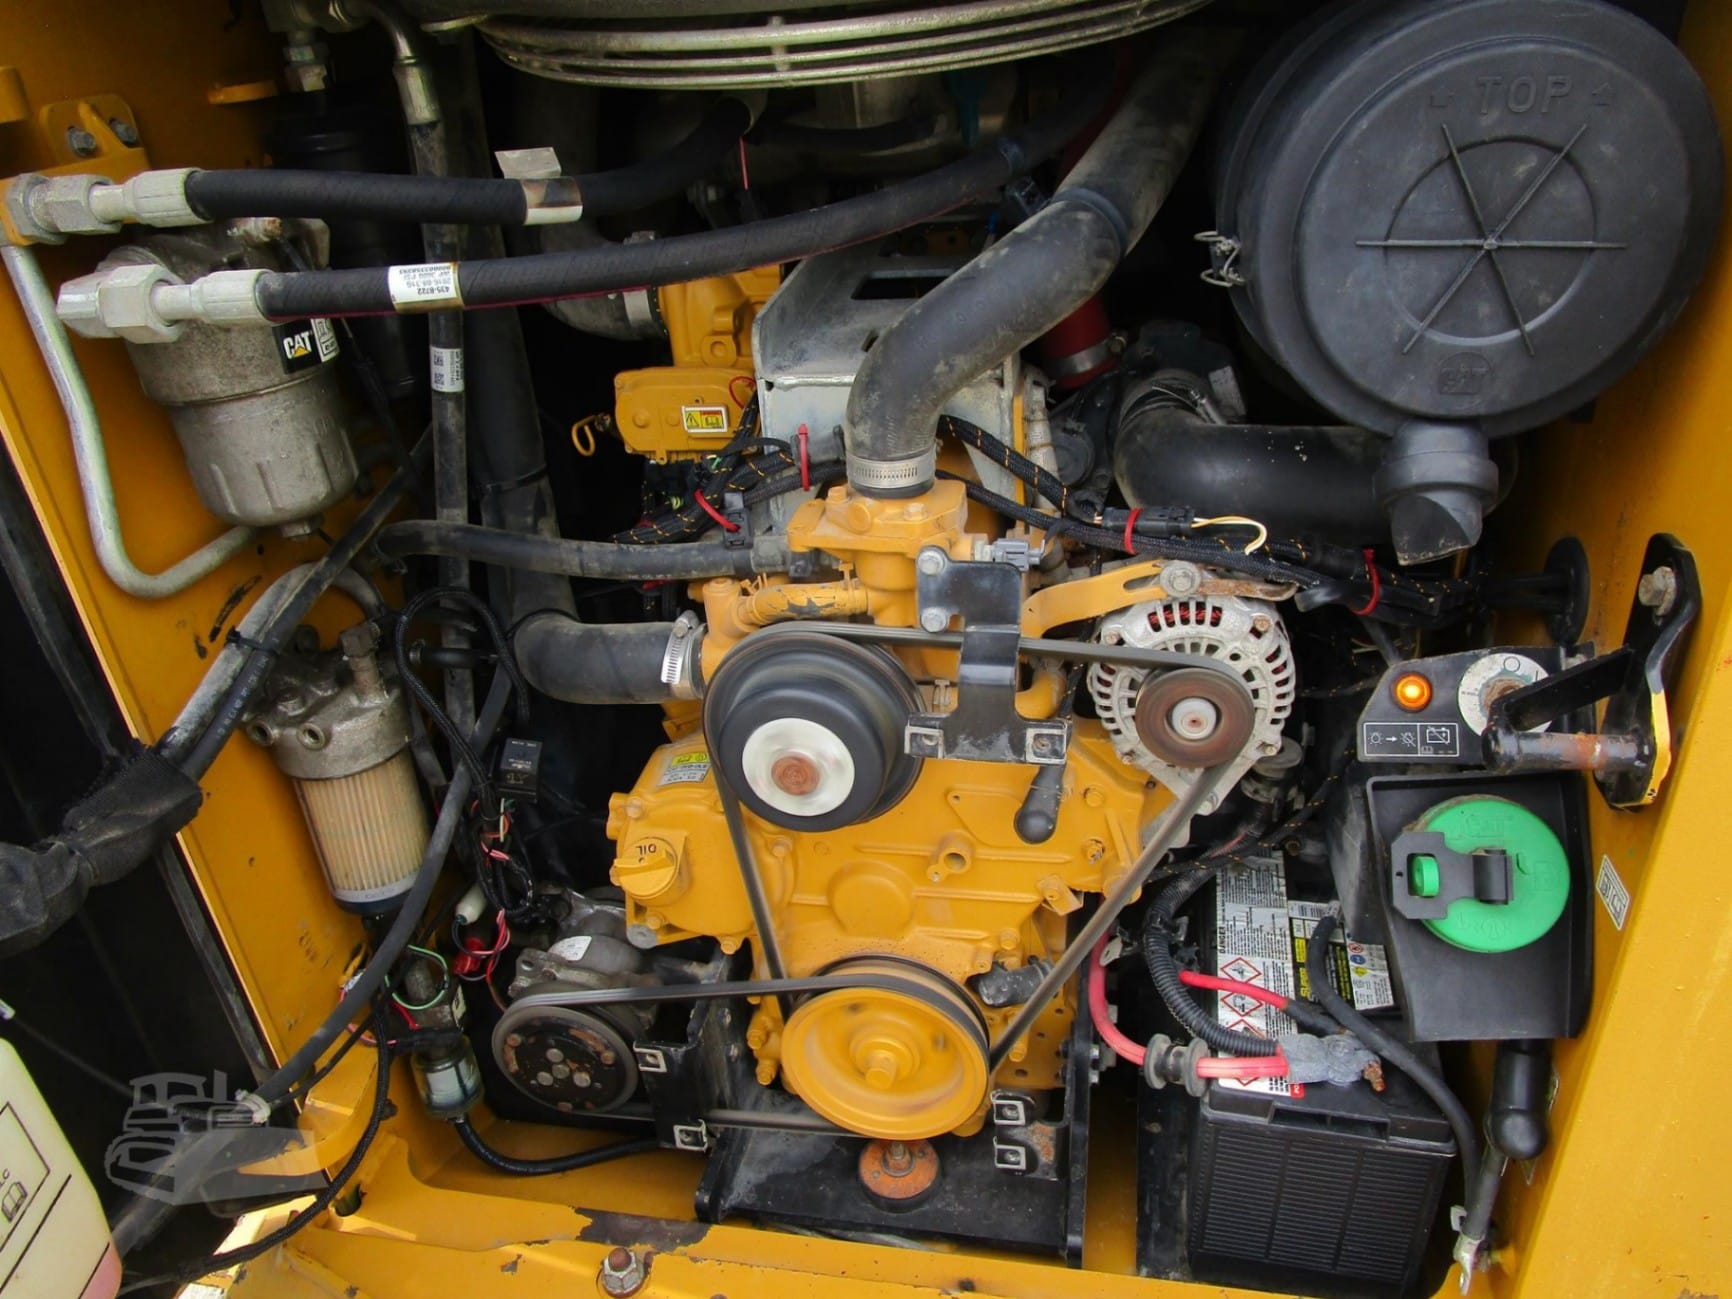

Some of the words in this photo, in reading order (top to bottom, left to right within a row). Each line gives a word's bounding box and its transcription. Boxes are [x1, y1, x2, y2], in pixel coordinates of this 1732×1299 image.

[1477, 73, 1573, 115] TOP
[283, 331, 312, 359] CAT
[635, 843, 657, 855] OIL
[1218, 926, 1226, 954] DANGER
